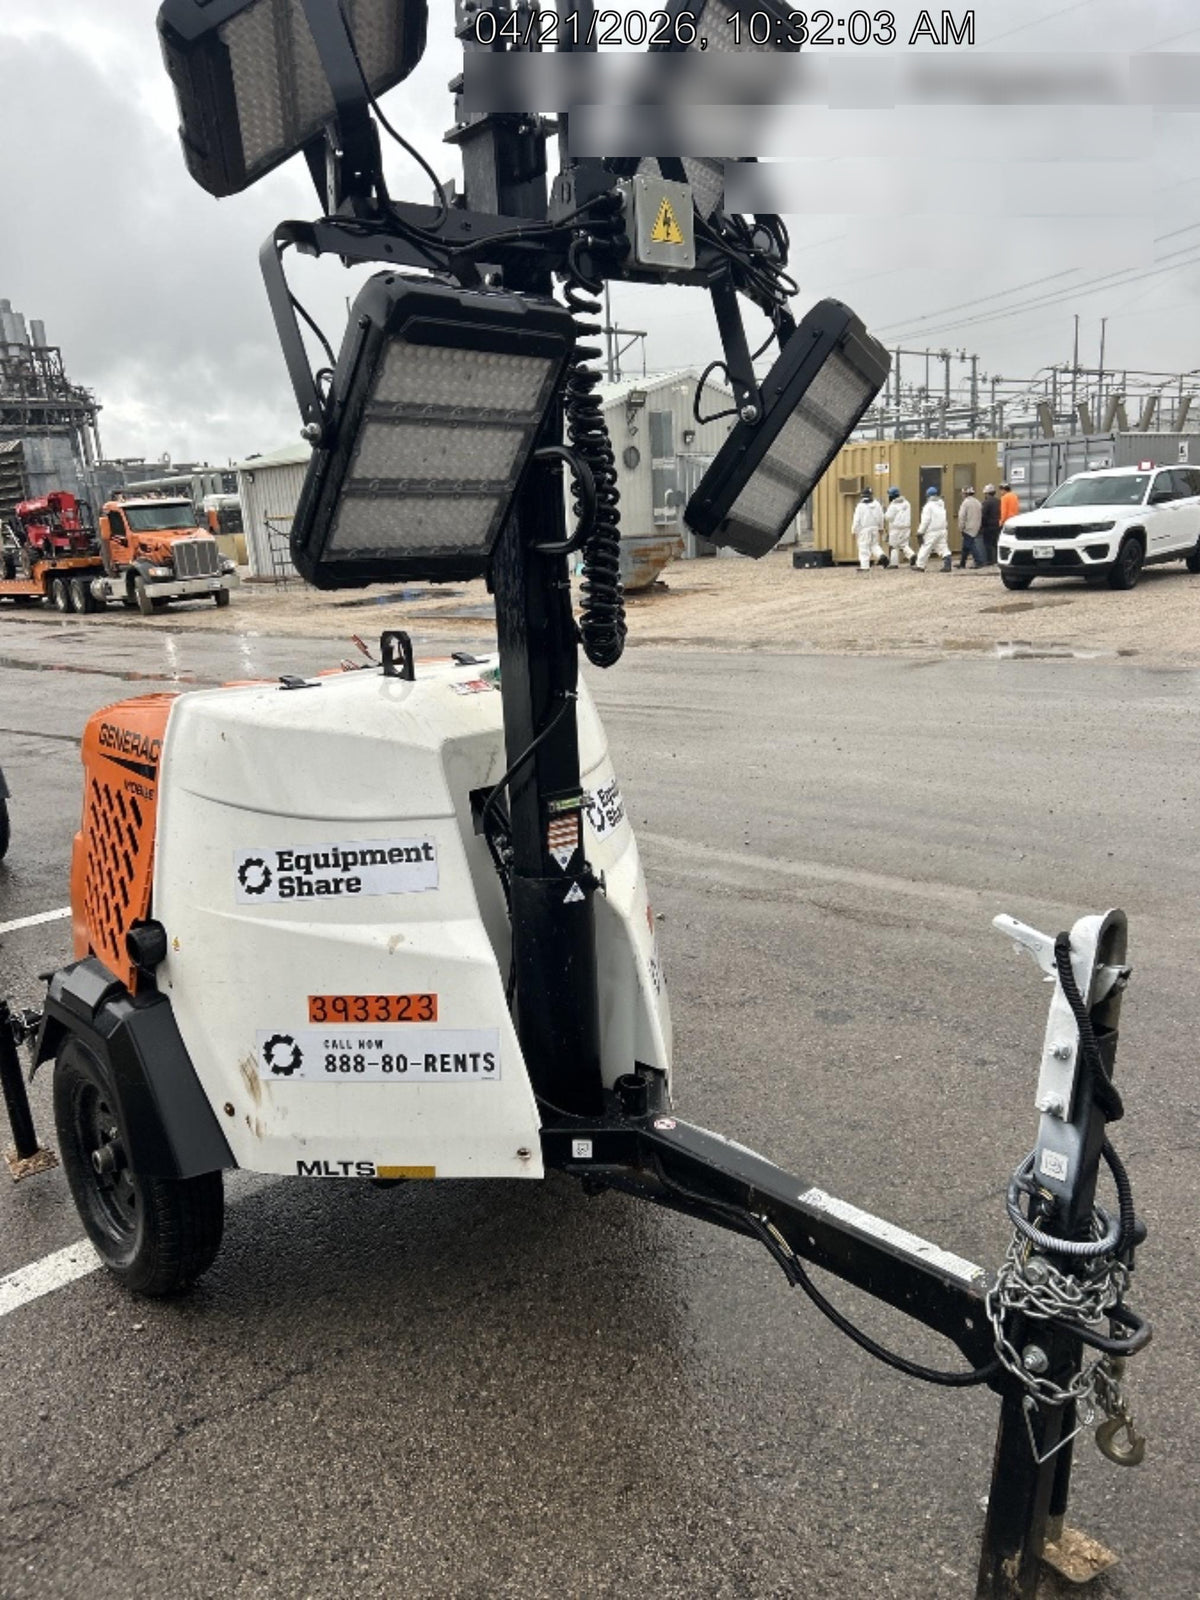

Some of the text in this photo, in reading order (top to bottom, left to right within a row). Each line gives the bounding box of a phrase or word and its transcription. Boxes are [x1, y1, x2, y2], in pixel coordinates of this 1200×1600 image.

[99, 722, 161, 763] GENERAC
[275, 842, 435, 875] Equipment
[278, 876, 362, 898] Share
[311, 994, 435, 1023] 393323
[323, 1039, 383, 1050] CALL NOW
[324, 1052, 496, 1074] 888-80-RENTS
[296, 1160, 376, 1176] MLTS
